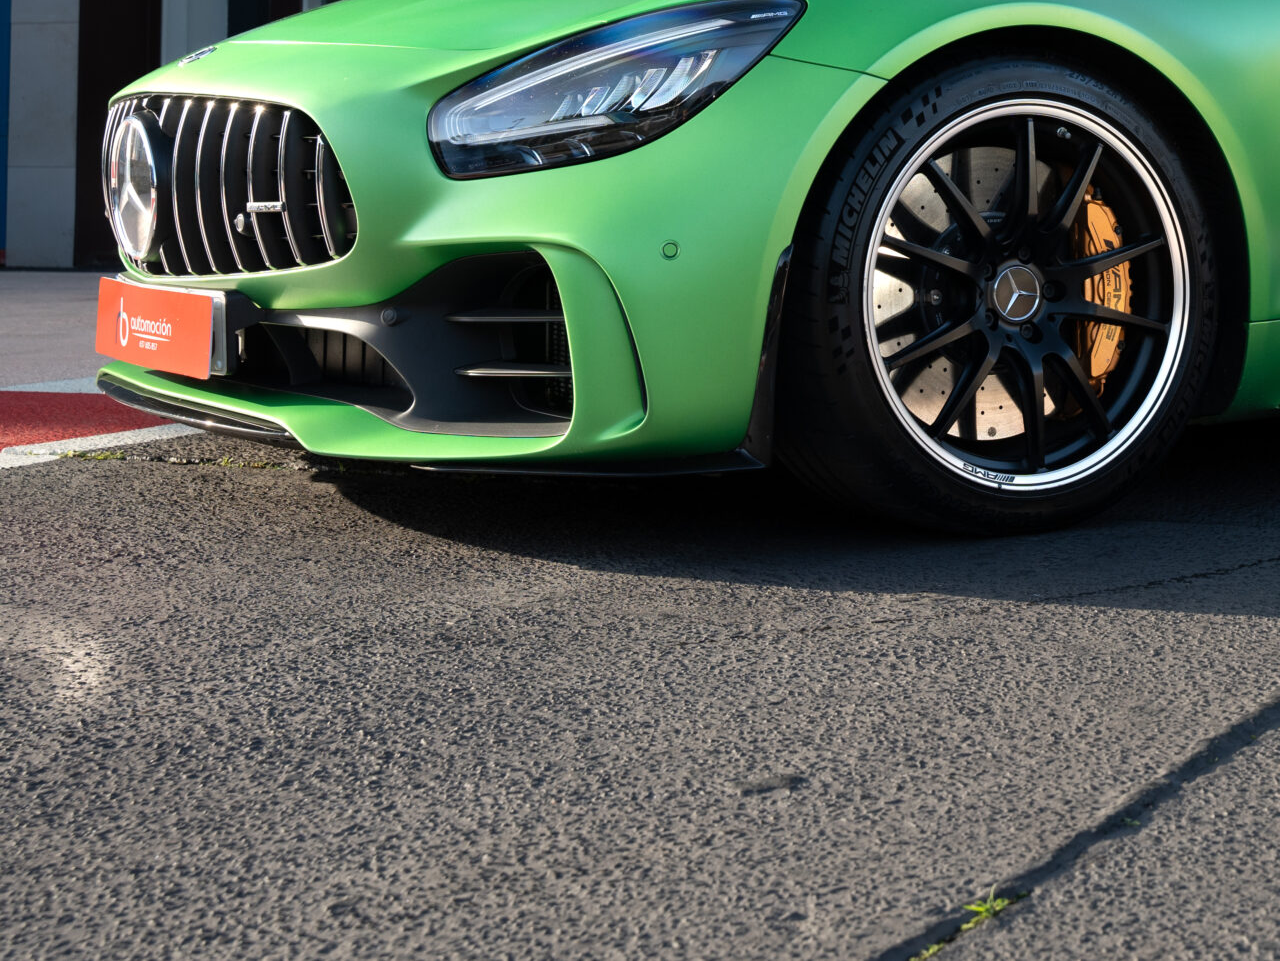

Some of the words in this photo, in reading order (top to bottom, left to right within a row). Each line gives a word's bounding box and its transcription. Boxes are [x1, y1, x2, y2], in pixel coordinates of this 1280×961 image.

[831, 127, 899, 268] MICHELIN
[130, 315, 172, 337] automoción
[962, 462, 1006, 481] AMG
